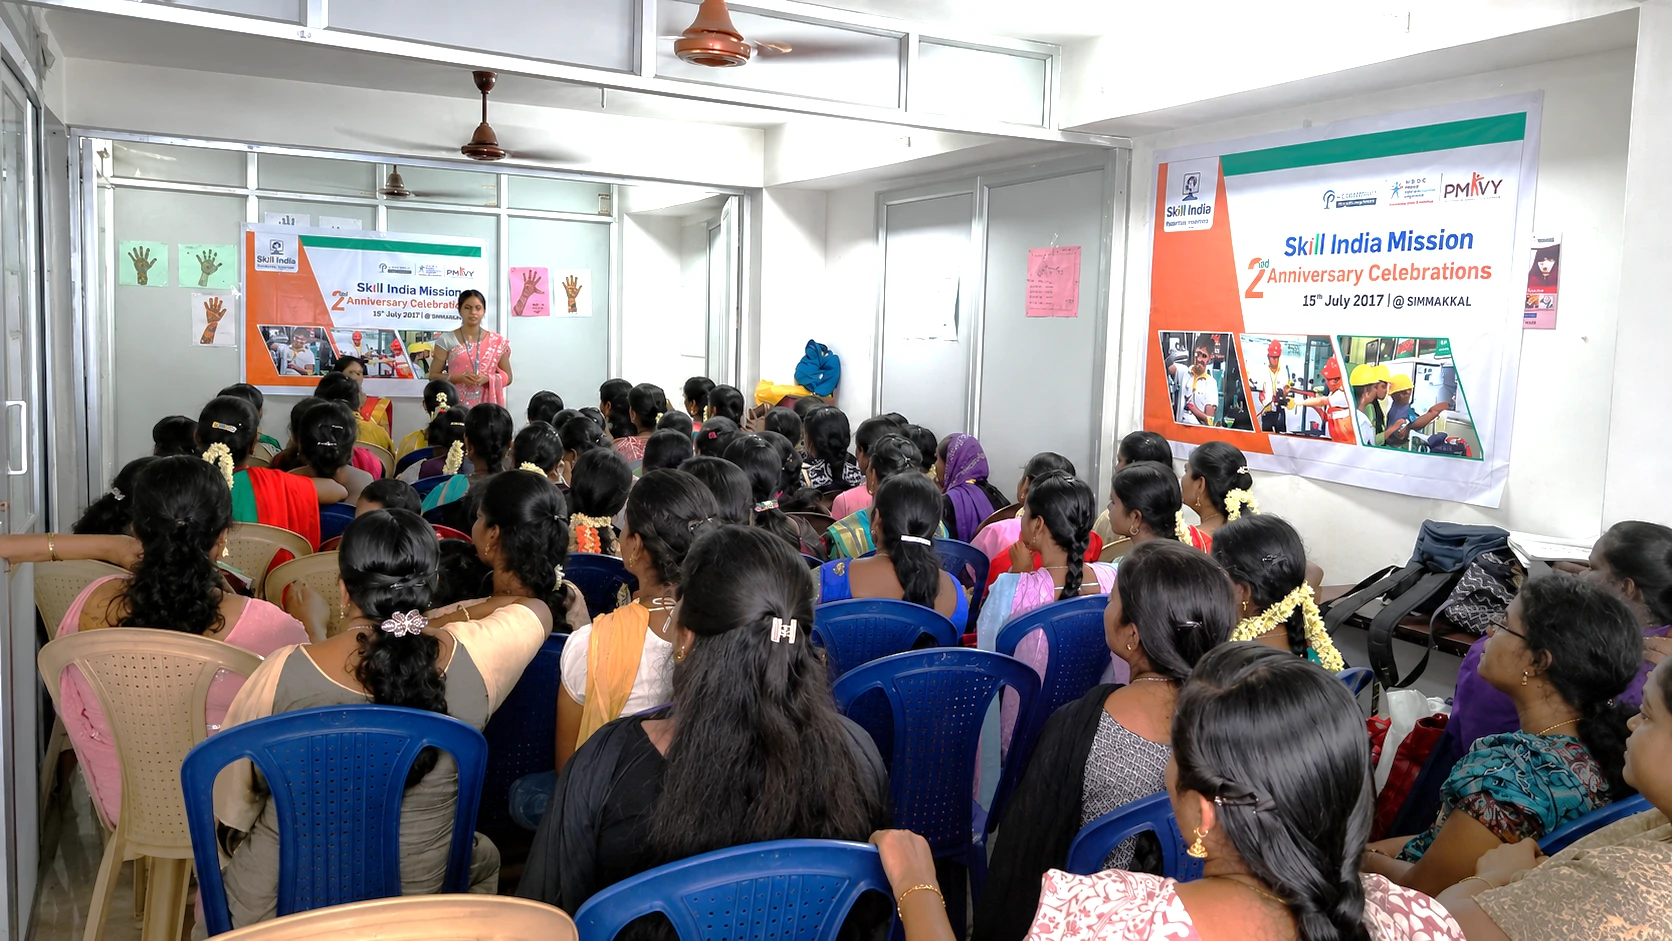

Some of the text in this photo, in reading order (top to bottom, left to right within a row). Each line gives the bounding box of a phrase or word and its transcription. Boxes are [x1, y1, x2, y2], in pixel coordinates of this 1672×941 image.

[1444, 172, 1503, 198] PMKVY
[1166, 203, 1212, 218] Skill India
[1284, 229, 1474, 257] Skill India Mission
[276, 256, 297, 265] India
[1266, 266, 1364, 287] Anniversary
[1368, 262, 1492, 281] Celebrations
[357, 282, 462, 297] Skill India Mission
[346, 296, 408, 309] Anniversary
[410, 299, 459, 309] Celebratio
[1324, 294, 1351, 309] July
[1353, 294, 1385, 307] 2017
[1407, 296, 1472, 307] SIMMAKKAL
[385, 311, 402, 319] July
